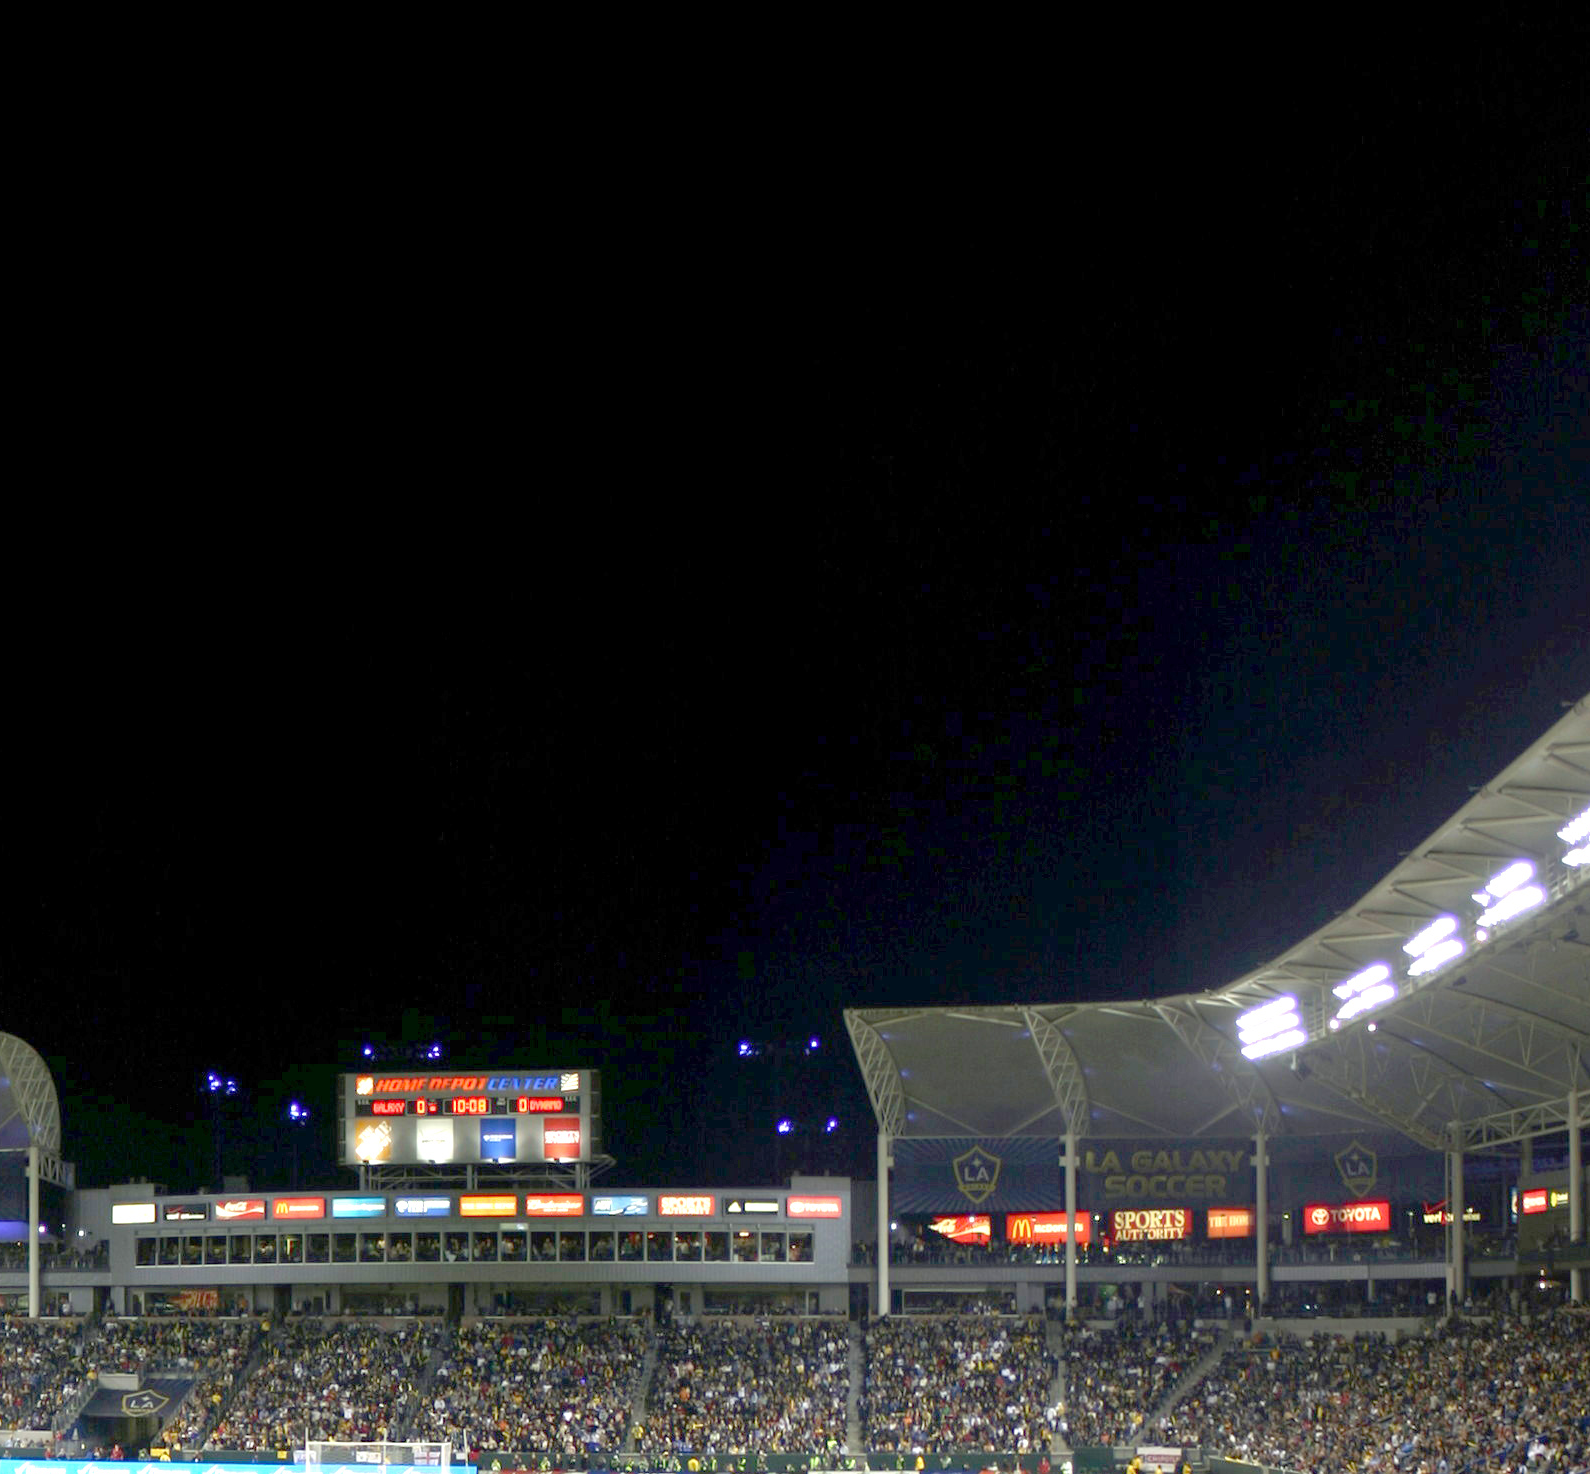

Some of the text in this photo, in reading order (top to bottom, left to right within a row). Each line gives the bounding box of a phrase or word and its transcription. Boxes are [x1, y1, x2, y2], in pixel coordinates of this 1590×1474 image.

[375, 1076, 558, 1093] HOME DEPOT CENTER
[451, 1099, 487, 1114] 10:08
[1085, 1149, 1246, 1173] LA GALAXY
[964, 1166, 990, 1182] LA
[1104, 1174, 1227, 1199] SOCCER
[661, 1197, 712, 1208] SPORTS
[1114, 1209, 1185, 1230] SPORTS
[1330, 1207, 1381, 1222] TOYOTA
